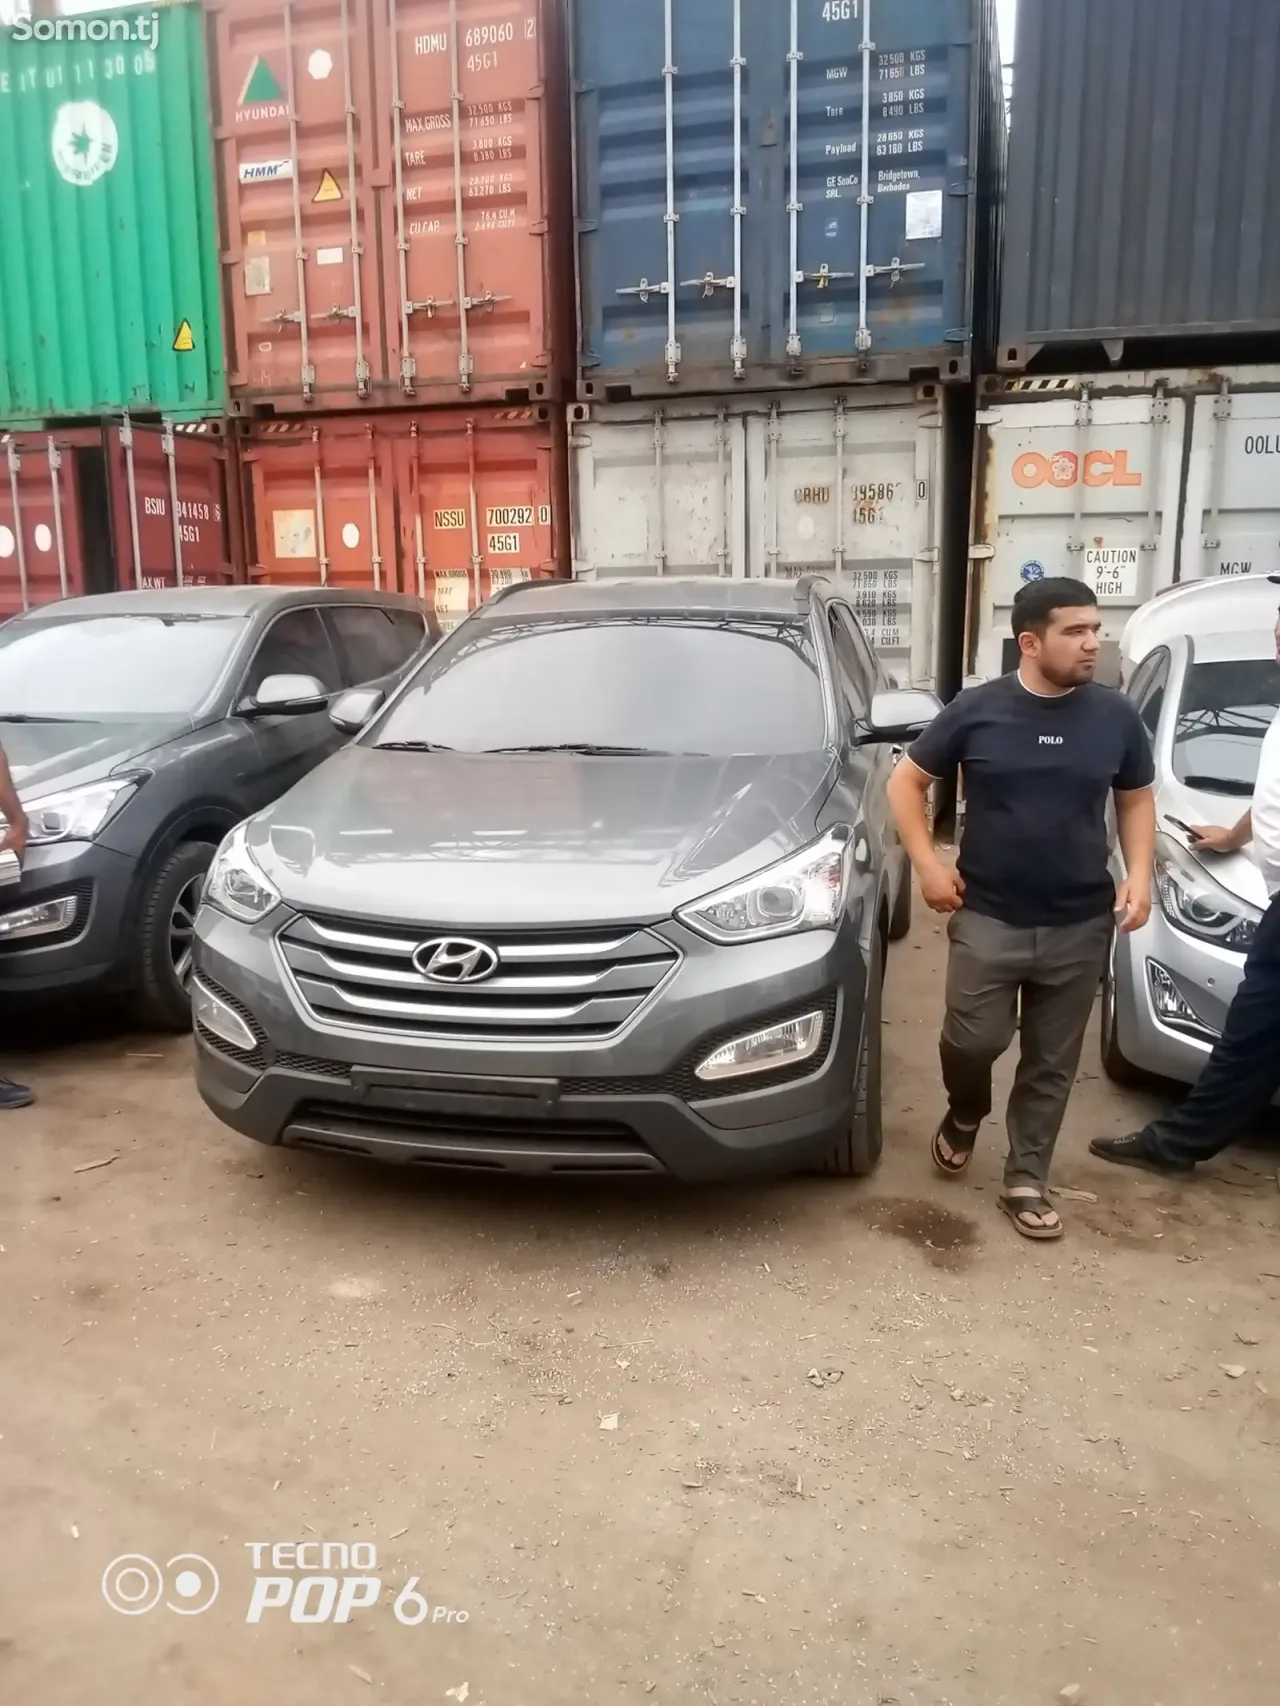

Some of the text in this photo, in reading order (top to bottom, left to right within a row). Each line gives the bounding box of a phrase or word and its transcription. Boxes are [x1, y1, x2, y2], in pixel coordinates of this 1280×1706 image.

[822, 0, 858, 21] 45G1
[415, 18, 536, 55] HDMU 689060 2
[467, 51, 497, 72] 45G1
[878, 50, 926, 66] 32500 KGS
[826, 68, 848, 80] MGW
[879, 64, 925, 80] 71650 LBS
[882, 88, 925, 102] 3850 KGS
[498, 101, 512, 112] KGS
[826, 106, 844, 116] Tare
[882, 103, 924, 117] 8490 LBS
[499, 113, 512, 124] LBS
[498, 136, 512, 147] KGS
[877, 129, 924, 142] 28650 KGS
[499, 148, 512, 159] LBS
[826, 143, 856, 156] Payload
[876, 141, 923, 155] 63160 LBS
[405, 150, 426, 167] TARE
[243, 165, 280, 179] HMM
[499, 173, 512, 182] KGS
[826, 175, 859, 187] GE SeaCo
[877, 182, 910, 193] Barbados
[407, 186, 422, 200] NET
[499, 183, 511, 194] LBS
[1012, 449, 1142, 489] OOCL
[917, 480, 926, 499] 0
[144, 497, 165, 515] BSIU
[176, 501, 209, 520] 941458
[435, 506, 548, 528] NSSU 700292 0
[489, 534, 518, 551] 45G1
[1086, 550, 1137, 563] CAUTION
[884, 571, 898, 580] KGS
[884, 579, 897, 588] LBS
[1096, 582, 1122, 595] HIGH
[883, 590, 897, 599] KGS
[882, 599, 896, 608] LBS
[883, 609, 897, 618] KGS
[882, 617, 896, 626] LBS
[1038, 736, 1064, 745] POLO
